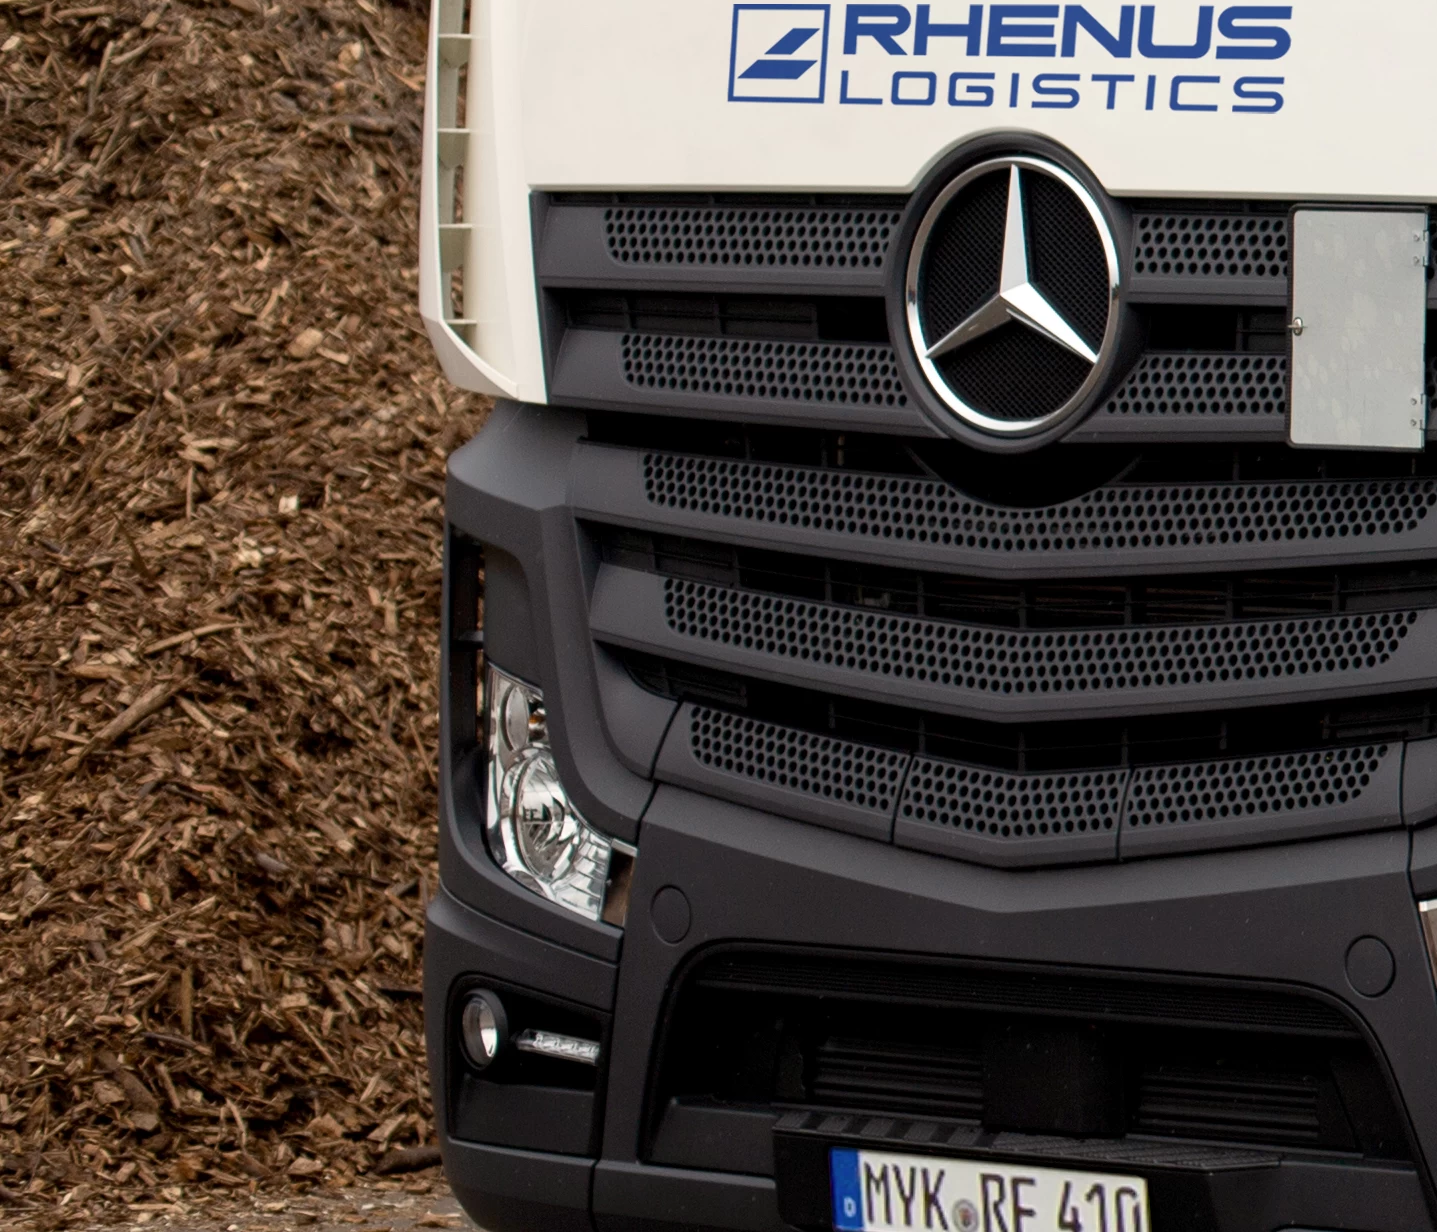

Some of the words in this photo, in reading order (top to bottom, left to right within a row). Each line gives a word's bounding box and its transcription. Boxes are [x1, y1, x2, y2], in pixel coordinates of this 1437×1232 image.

[842, 4, 1293, 60] RHENUS
[839, 69, 1286, 114] LOGISTICS
[863, 1161, 949, 1231] MYK
[1058, 1180, 1143, 1232] 410
